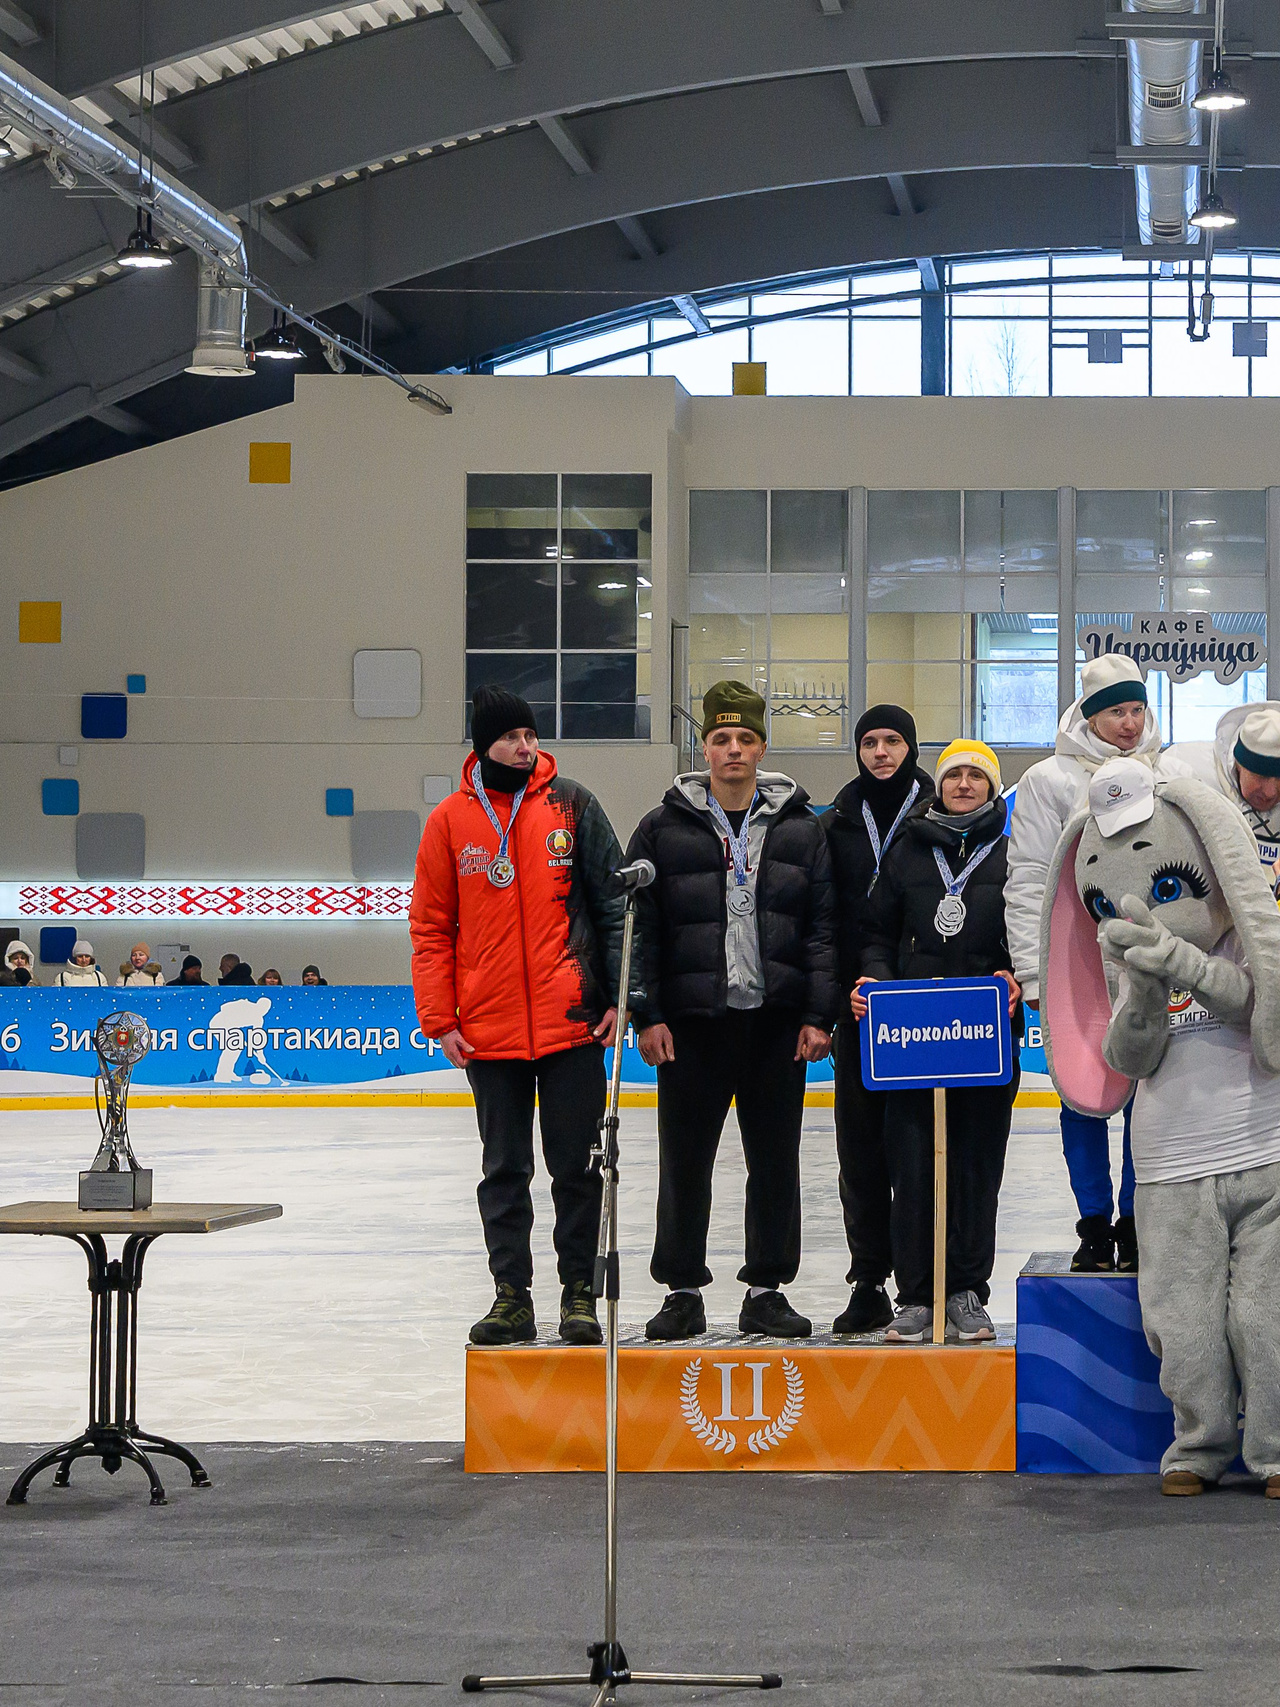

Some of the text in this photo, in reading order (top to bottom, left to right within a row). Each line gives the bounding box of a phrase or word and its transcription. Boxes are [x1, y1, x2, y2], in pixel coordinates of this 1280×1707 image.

[1140, 619, 1205, 635] КАФЕ
[187, 1027, 401, 1057] спартакиада
[877, 1018, 995, 1049] Агрохолдинг
[712, 1362, 771, 1421] II
